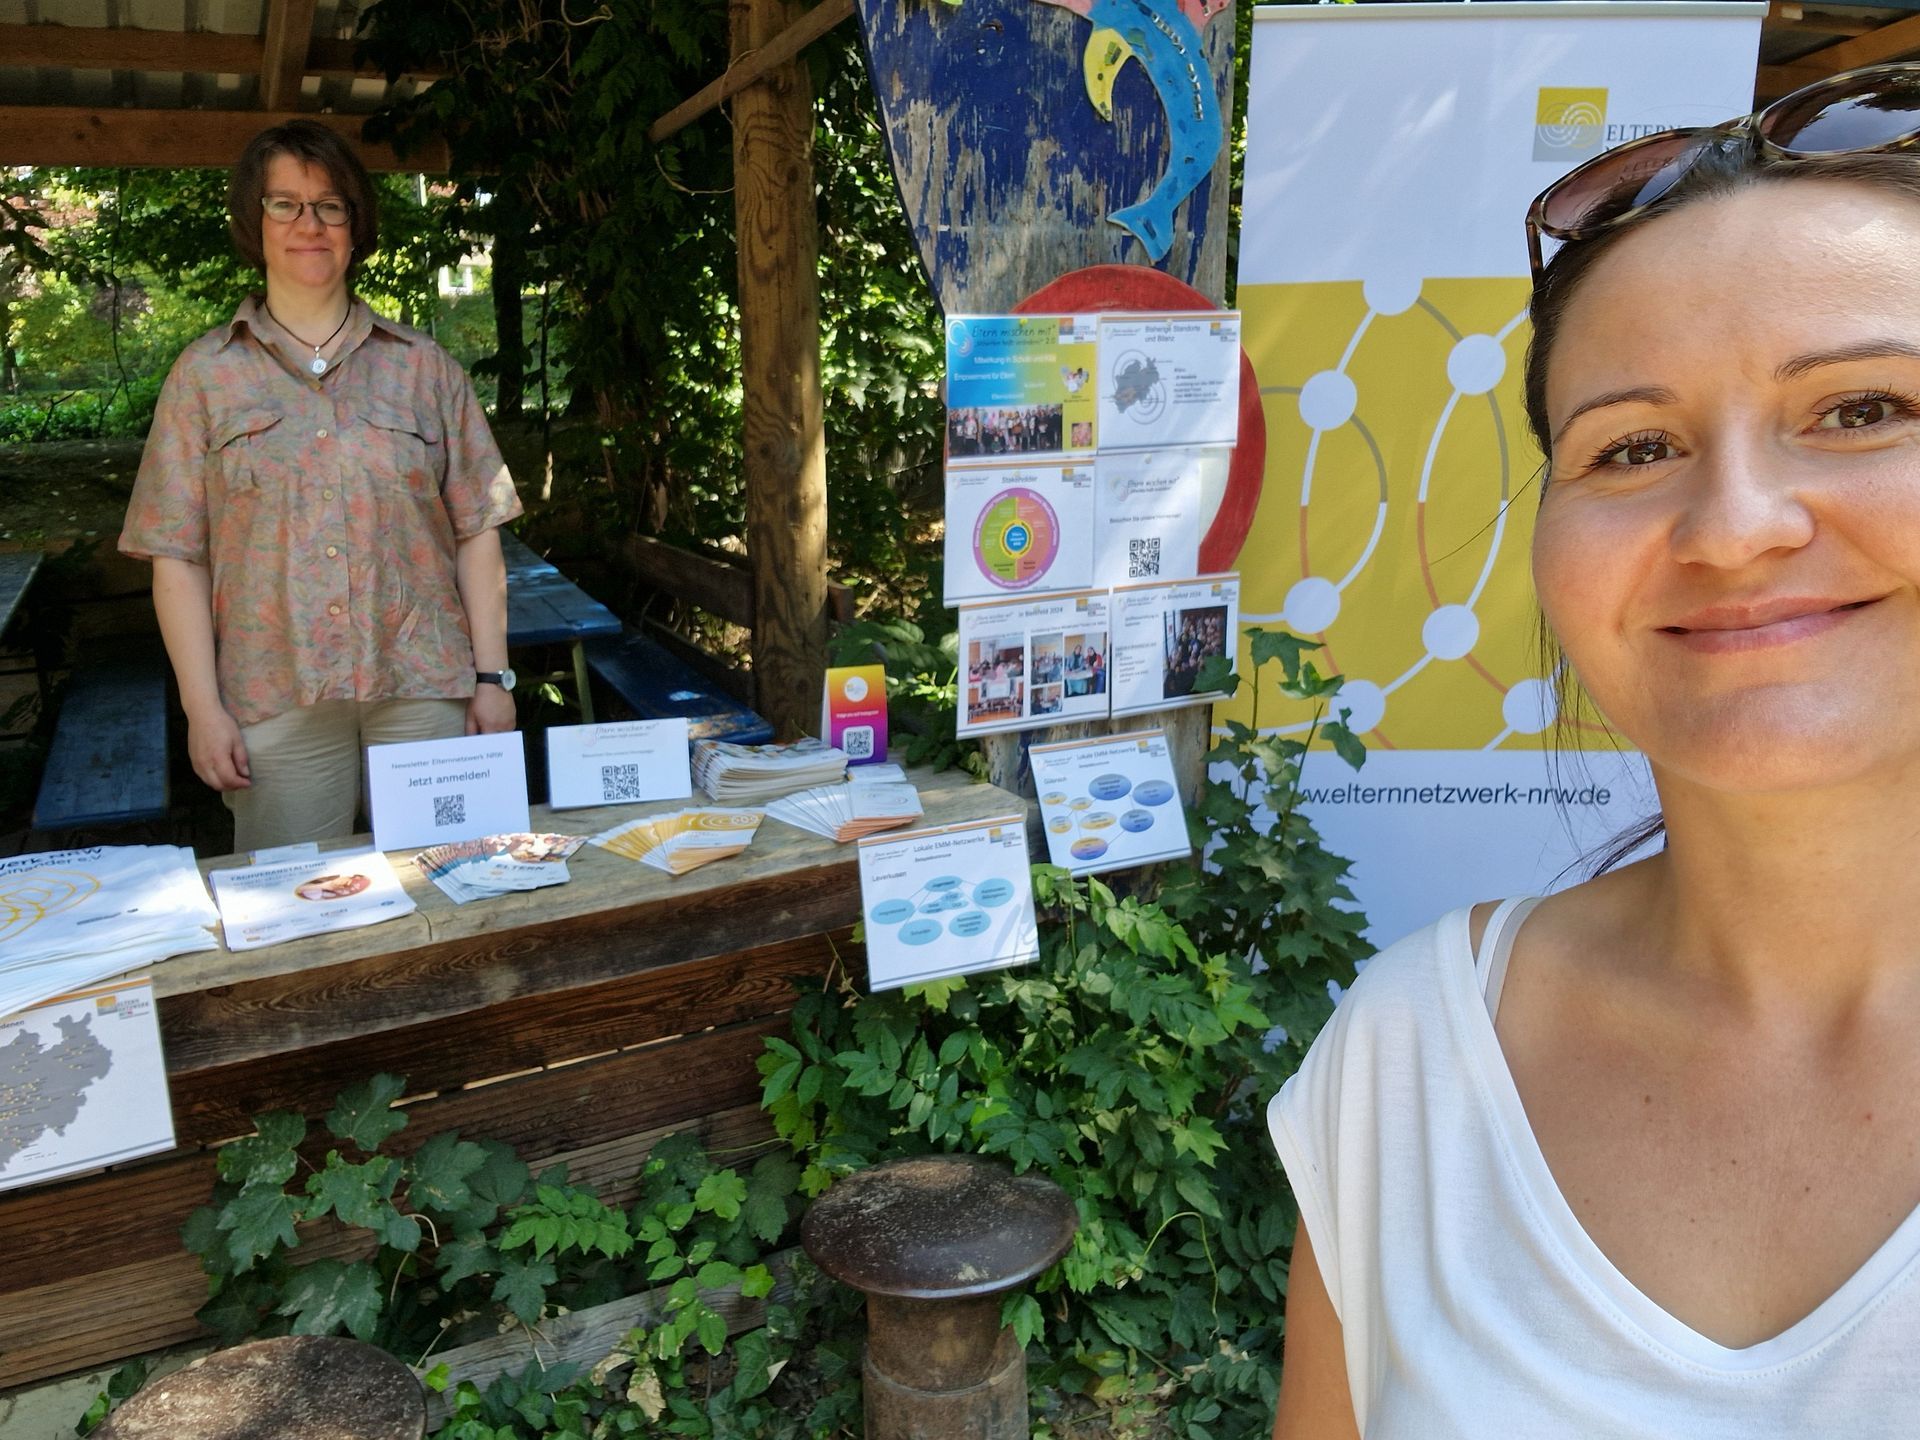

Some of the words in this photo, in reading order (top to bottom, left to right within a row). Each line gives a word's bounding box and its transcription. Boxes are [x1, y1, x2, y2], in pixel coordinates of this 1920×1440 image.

[391, 760, 430, 770] Newsletter
[431, 754, 484, 766] Elternnetzwerk
[485, 751, 504, 760] NRW
[408, 777, 433, 788] Jetzt
[435, 769, 491, 785] anmelden!
[1302, 782, 1612, 805] w.elternnetzwerk-nrw.de
[913, 843, 934, 854] Lokale
[872, 871, 908, 883] Leverkusen
